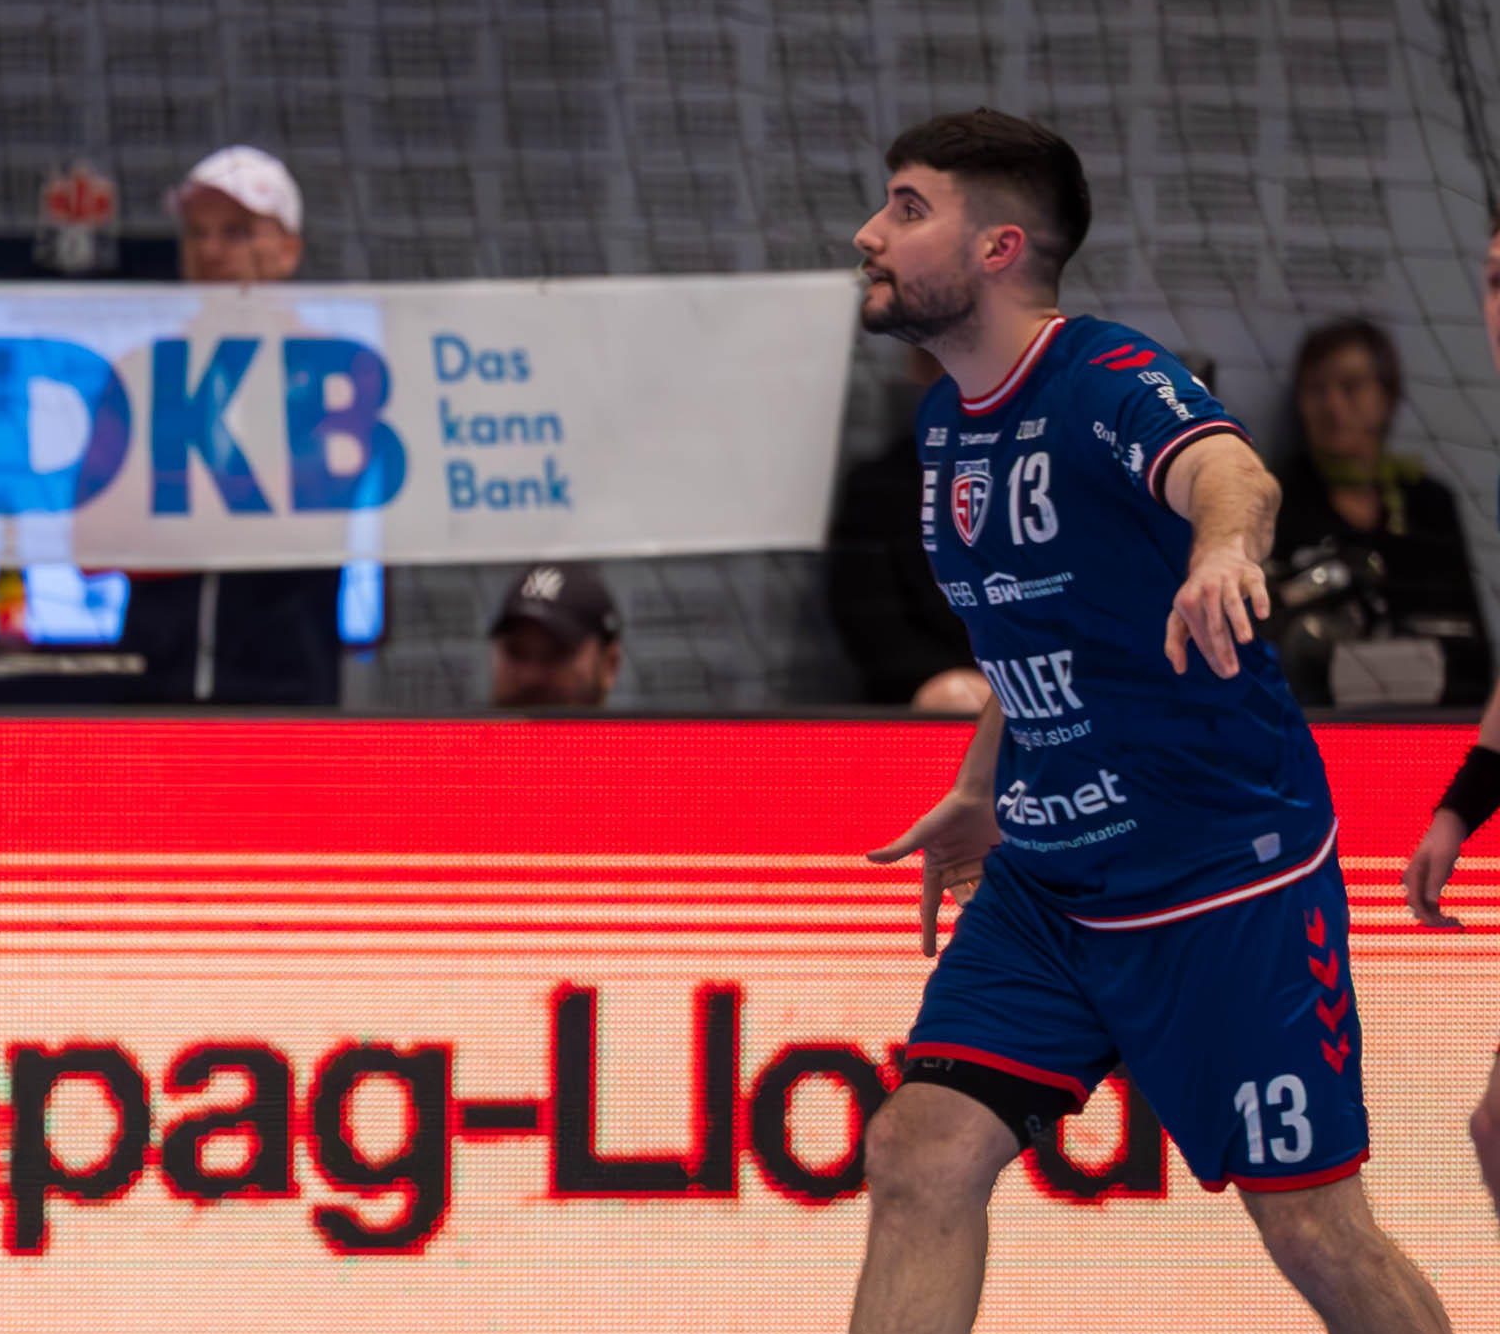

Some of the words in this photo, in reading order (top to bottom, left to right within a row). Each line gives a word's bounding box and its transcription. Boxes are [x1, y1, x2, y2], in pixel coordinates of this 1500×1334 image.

[431, 332, 531, 383] Das
[438, 397, 564, 448] kann
[445, 458, 573, 512] Bank
[1007, 451, 1060, 545] 13
[978, 649, 1085, 719] OLLER
[1234, 1073, 1314, 1165] 13
